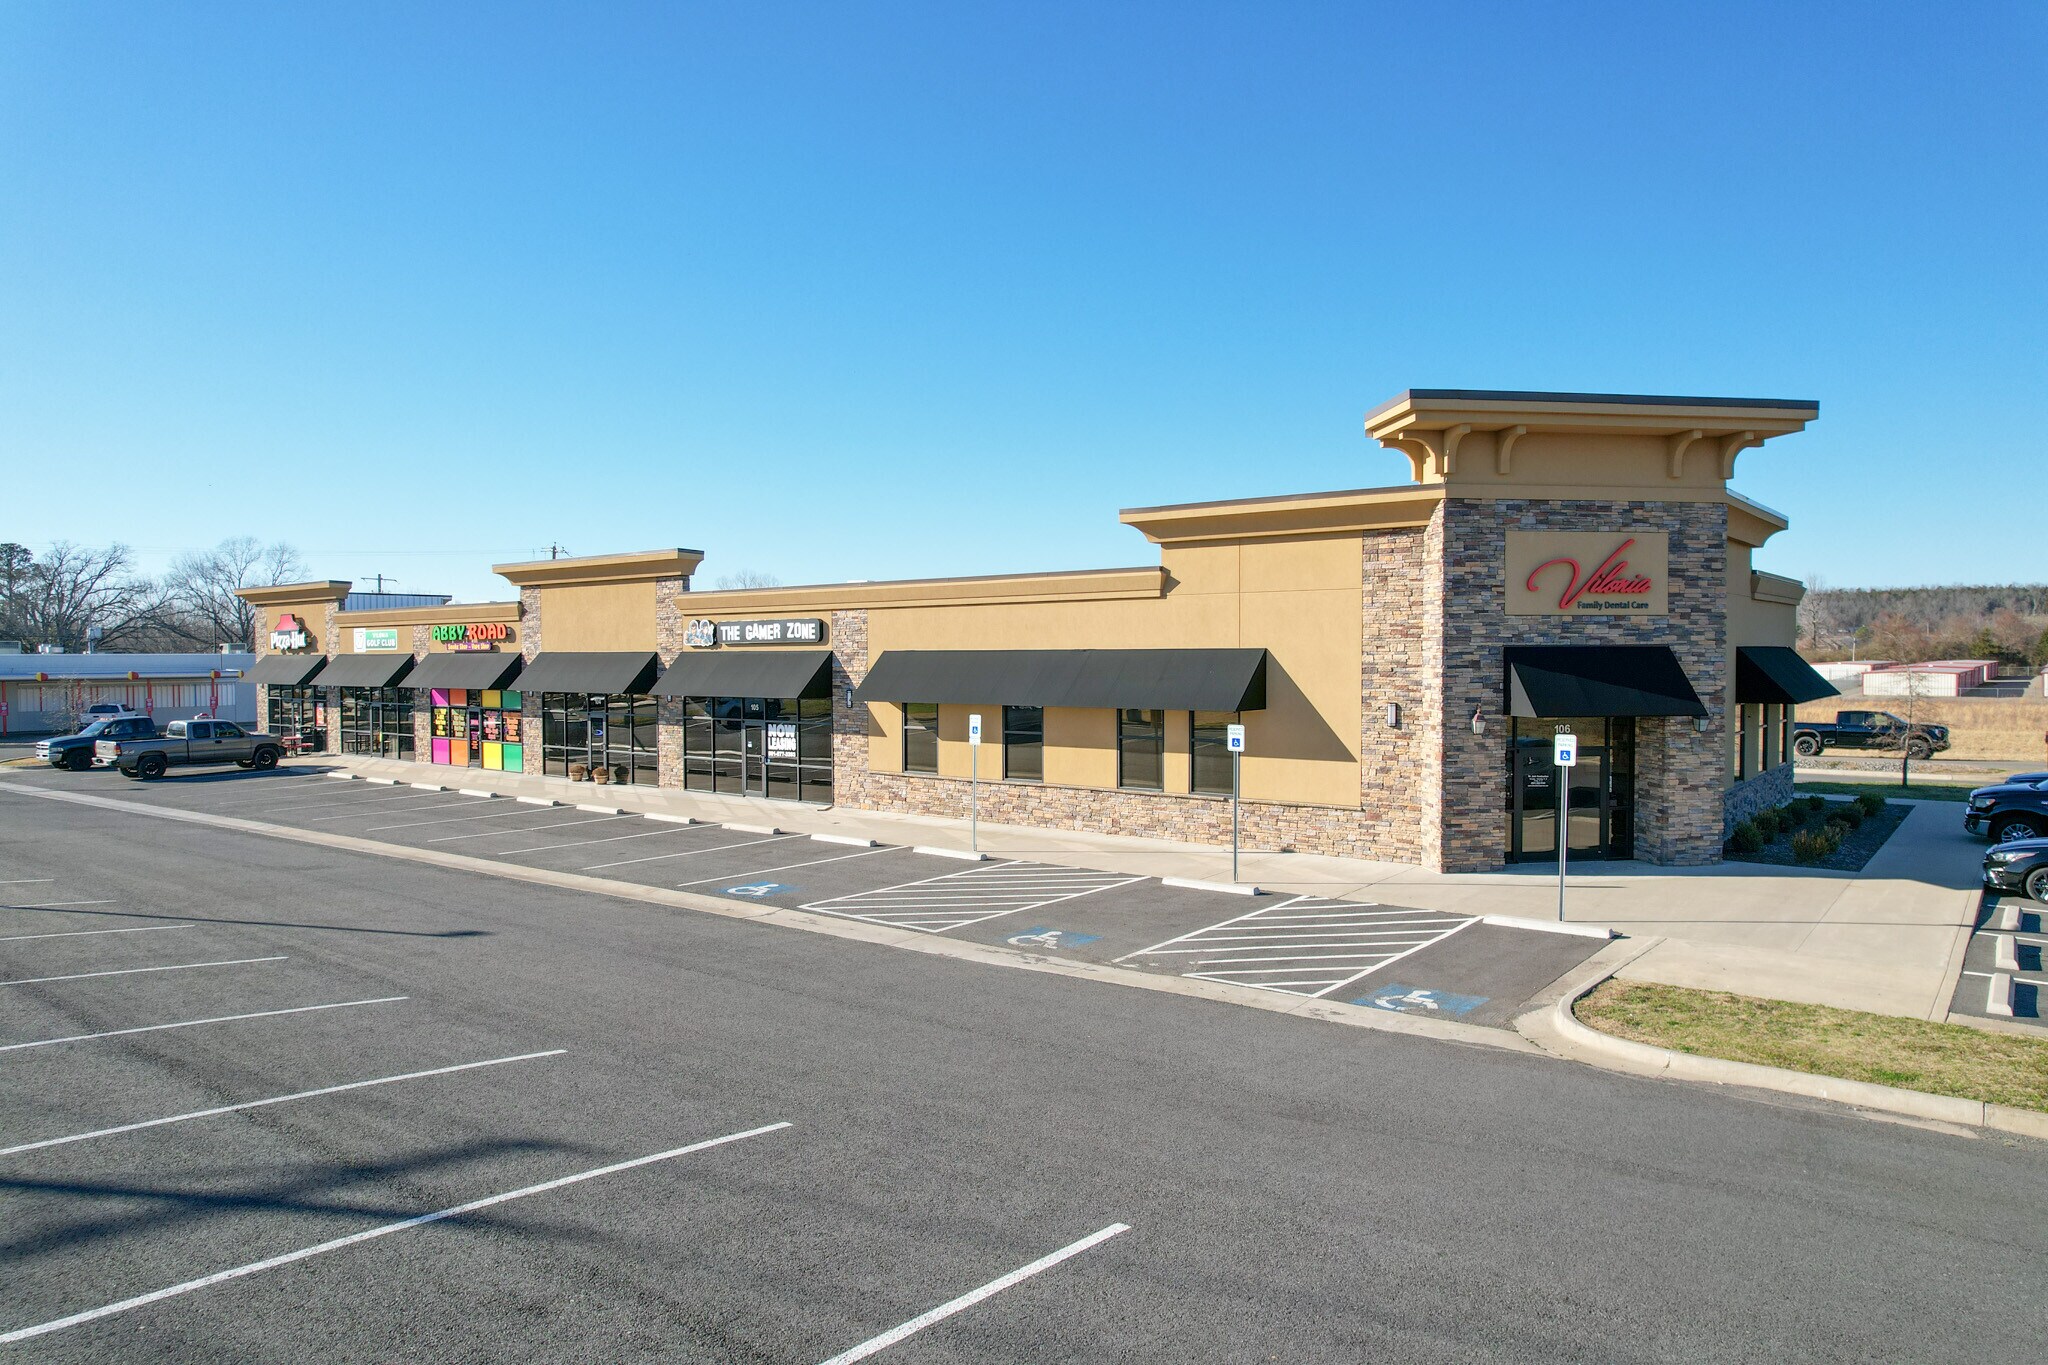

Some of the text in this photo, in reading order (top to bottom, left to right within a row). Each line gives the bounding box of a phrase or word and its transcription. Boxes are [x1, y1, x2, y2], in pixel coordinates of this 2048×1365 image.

[1527, 538, 1652, 609] Vilonia
[1577, 601, 1649, 611] Family Dental Care
[432, 623, 507, 641] ABBY ROAD
[720, 622, 816, 641] THE GAMER ZONE
[270, 631, 307, 650] Pizza Hut
[367, 638, 396, 648] GOLF CLUB
[768, 723, 796, 738] NOW
[1554, 724, 1571, 734] 106
[768, 737, 797, 751] LEASING
